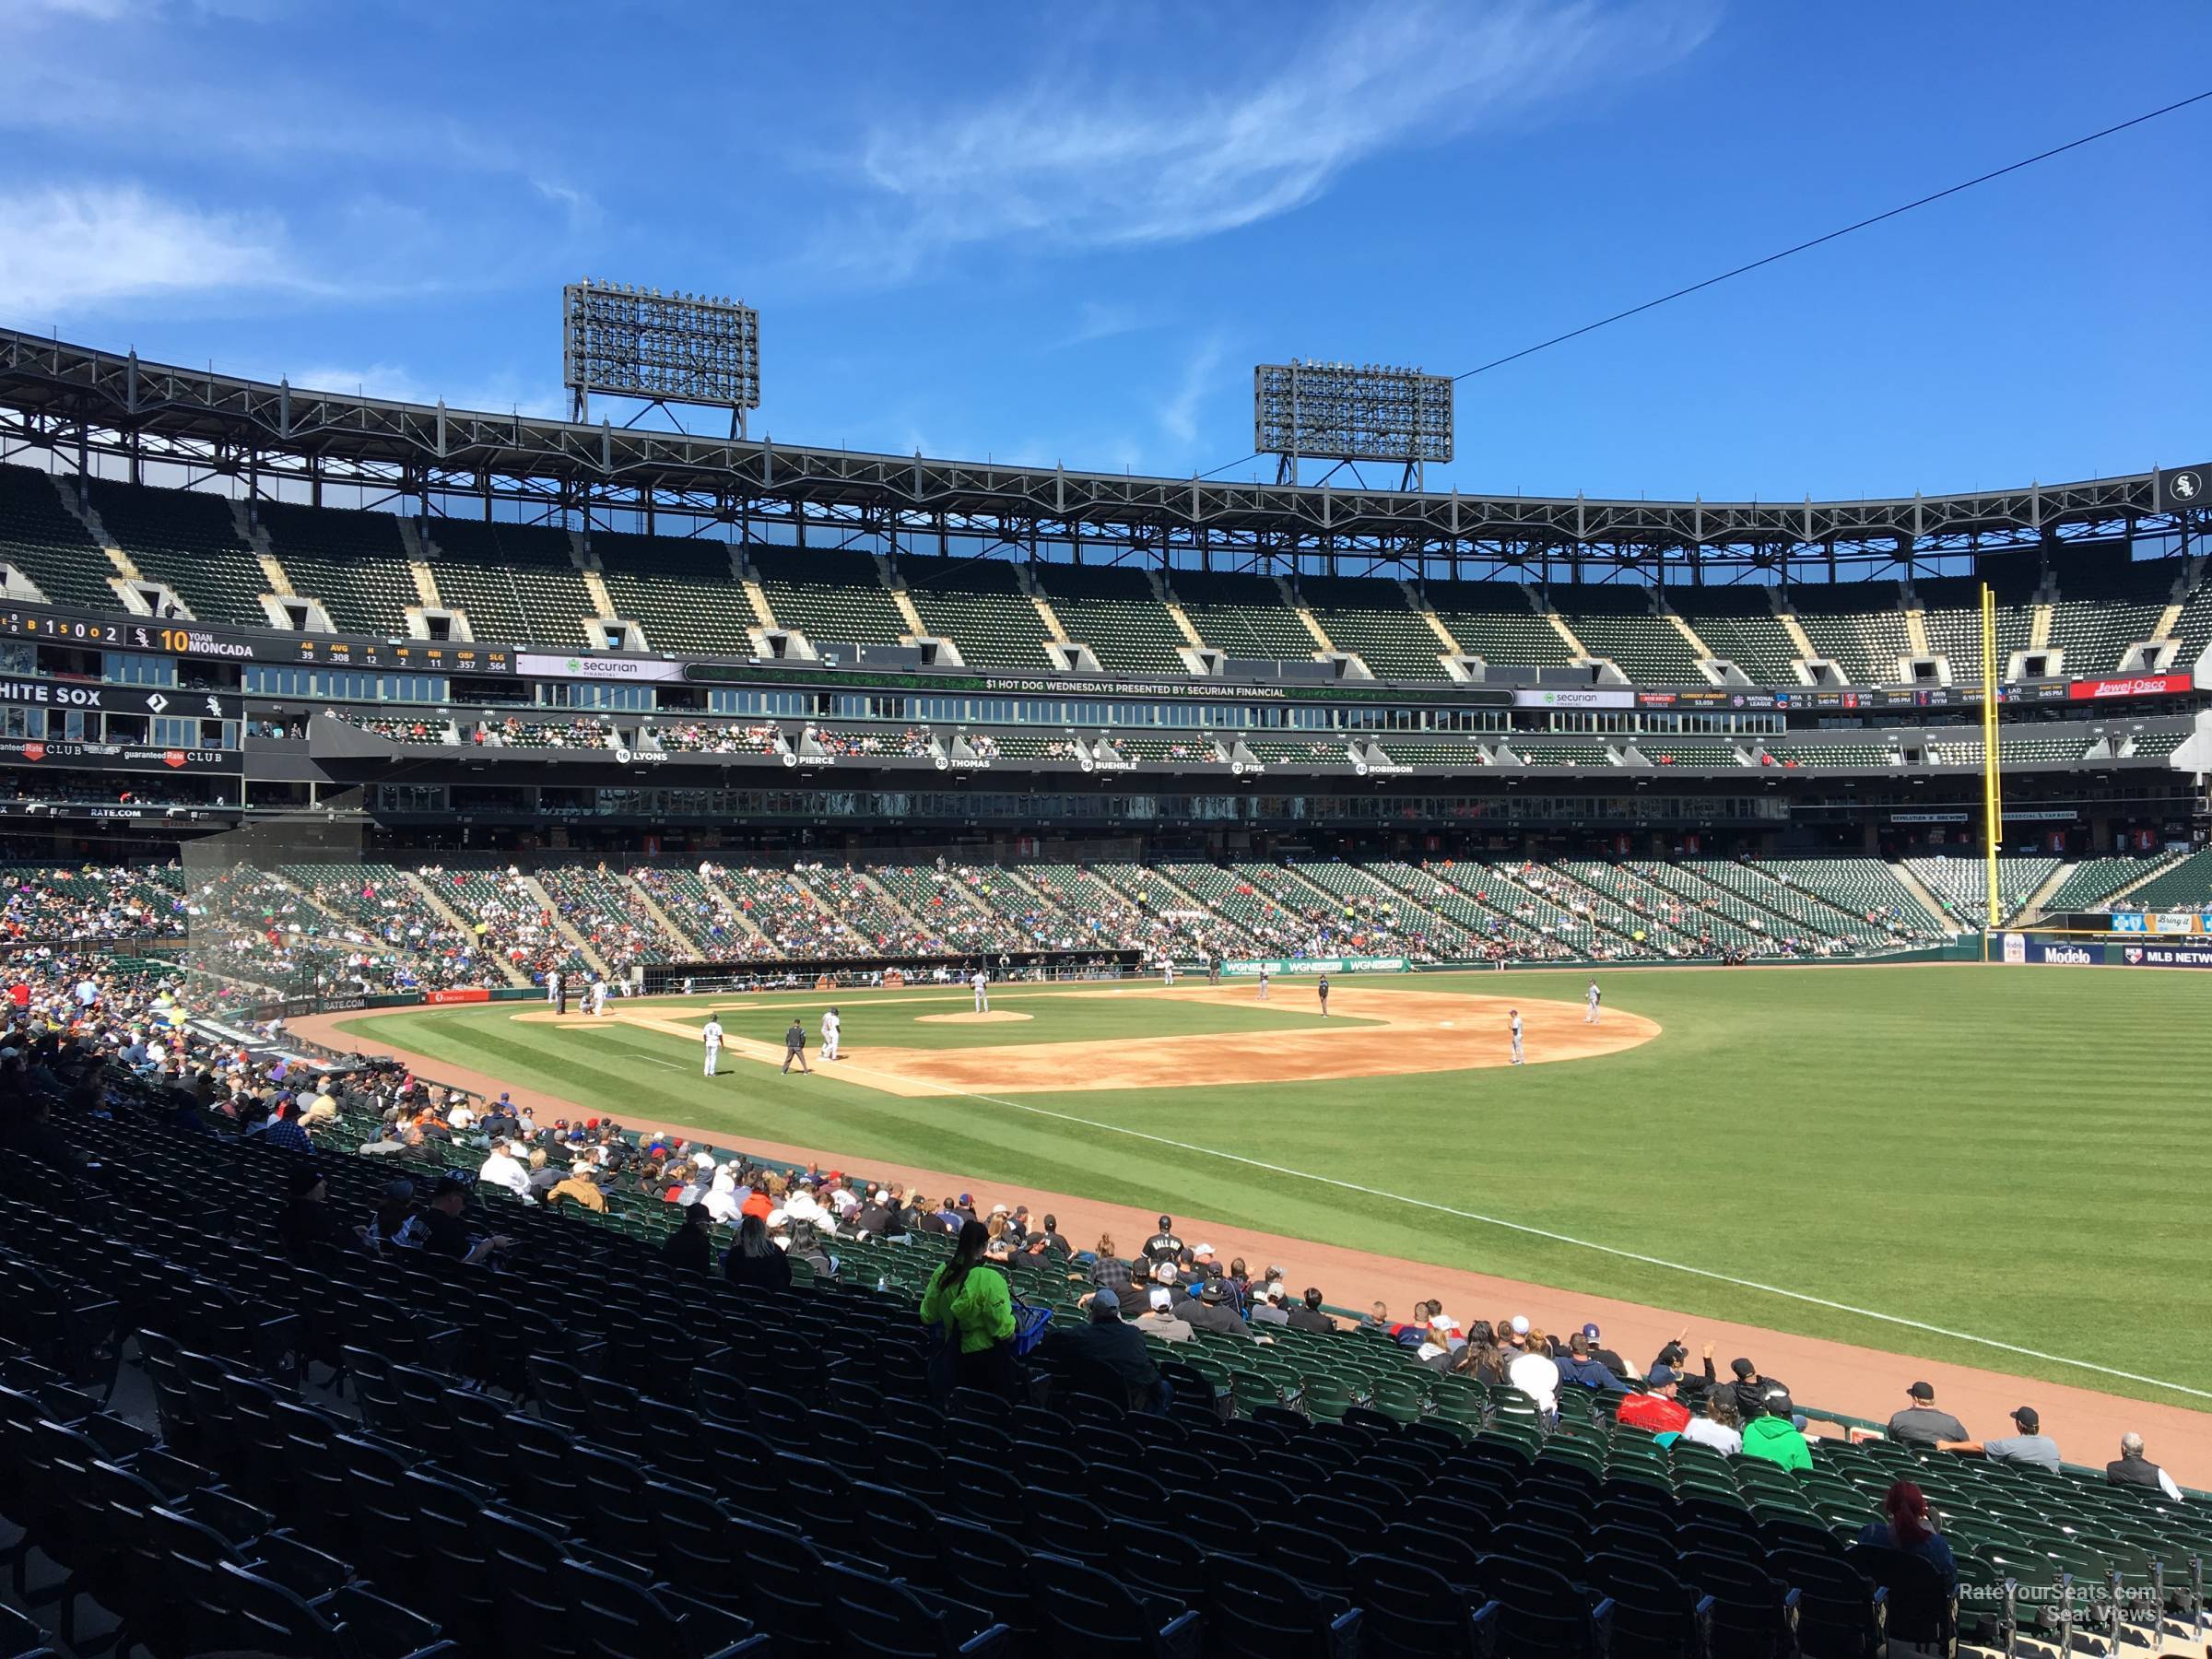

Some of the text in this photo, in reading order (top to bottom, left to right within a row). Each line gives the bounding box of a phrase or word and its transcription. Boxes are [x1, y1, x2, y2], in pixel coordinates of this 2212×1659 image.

[28, 619, 36, 629] B
[46, 619, 53, 634] 1
[60, 624, 68, 634] S
[75, 623, 85, 638] 0
[106, 627, 116, 641] 2
[160, 629, 189, 652] 10
[188, 632, 213, 642] YOAN
[188, 641, 253, 657] MONCADA
[300, 641, 313, 650] AB
[330, 644, 348, 653] AVG
[301, 651, 313, 660] 39
[330, 653, 349, 663] .308
[366, 655, 377, 665] 12
[400, 657, 406, 665] 2
[430, 659, 441, 667] 11
[456, 661, 476, 669] .357
[488, 662, 506, 671] .564
[583, 661, 638, 673] securian
[986, 680, 1286, 698] $1 HOT DOG WEDNESDAYS PRESENTED BY SECURIAN FINANCIAL
[56, 687, 101, 706] SOX
[1557, 692, 1597, 701] securian
[25, 744, 44, 753] Rate
[46, 745, 82, 756] CLUB
[124, 750, 222, 762] guaranteed Rate CLUB
[632, 752, 668, 761] LYONS
[798, 756, 835, 766] PIERCE
[950, 759, 990, 769] THOMAS
[1095, 761, 1137, 771] BUEHRLE
[1245, 764, 1265, 772] FISK
[1369, 765, 1413, 774] ROBINSON
[90, 808, 142, 818] RATE.COM
[2158, 914, 2182, 926] Bring
[2045, 947, 2091, 964] Modelo
[2147, 951, 2173, 962] MLB
[1226, 962, 1252, 972] WGN
[1288, 962, 1312, 972] WGN
[1350, 960, 1374, 971] WGN
[324, 998, 365, 1010] RATE.COM
